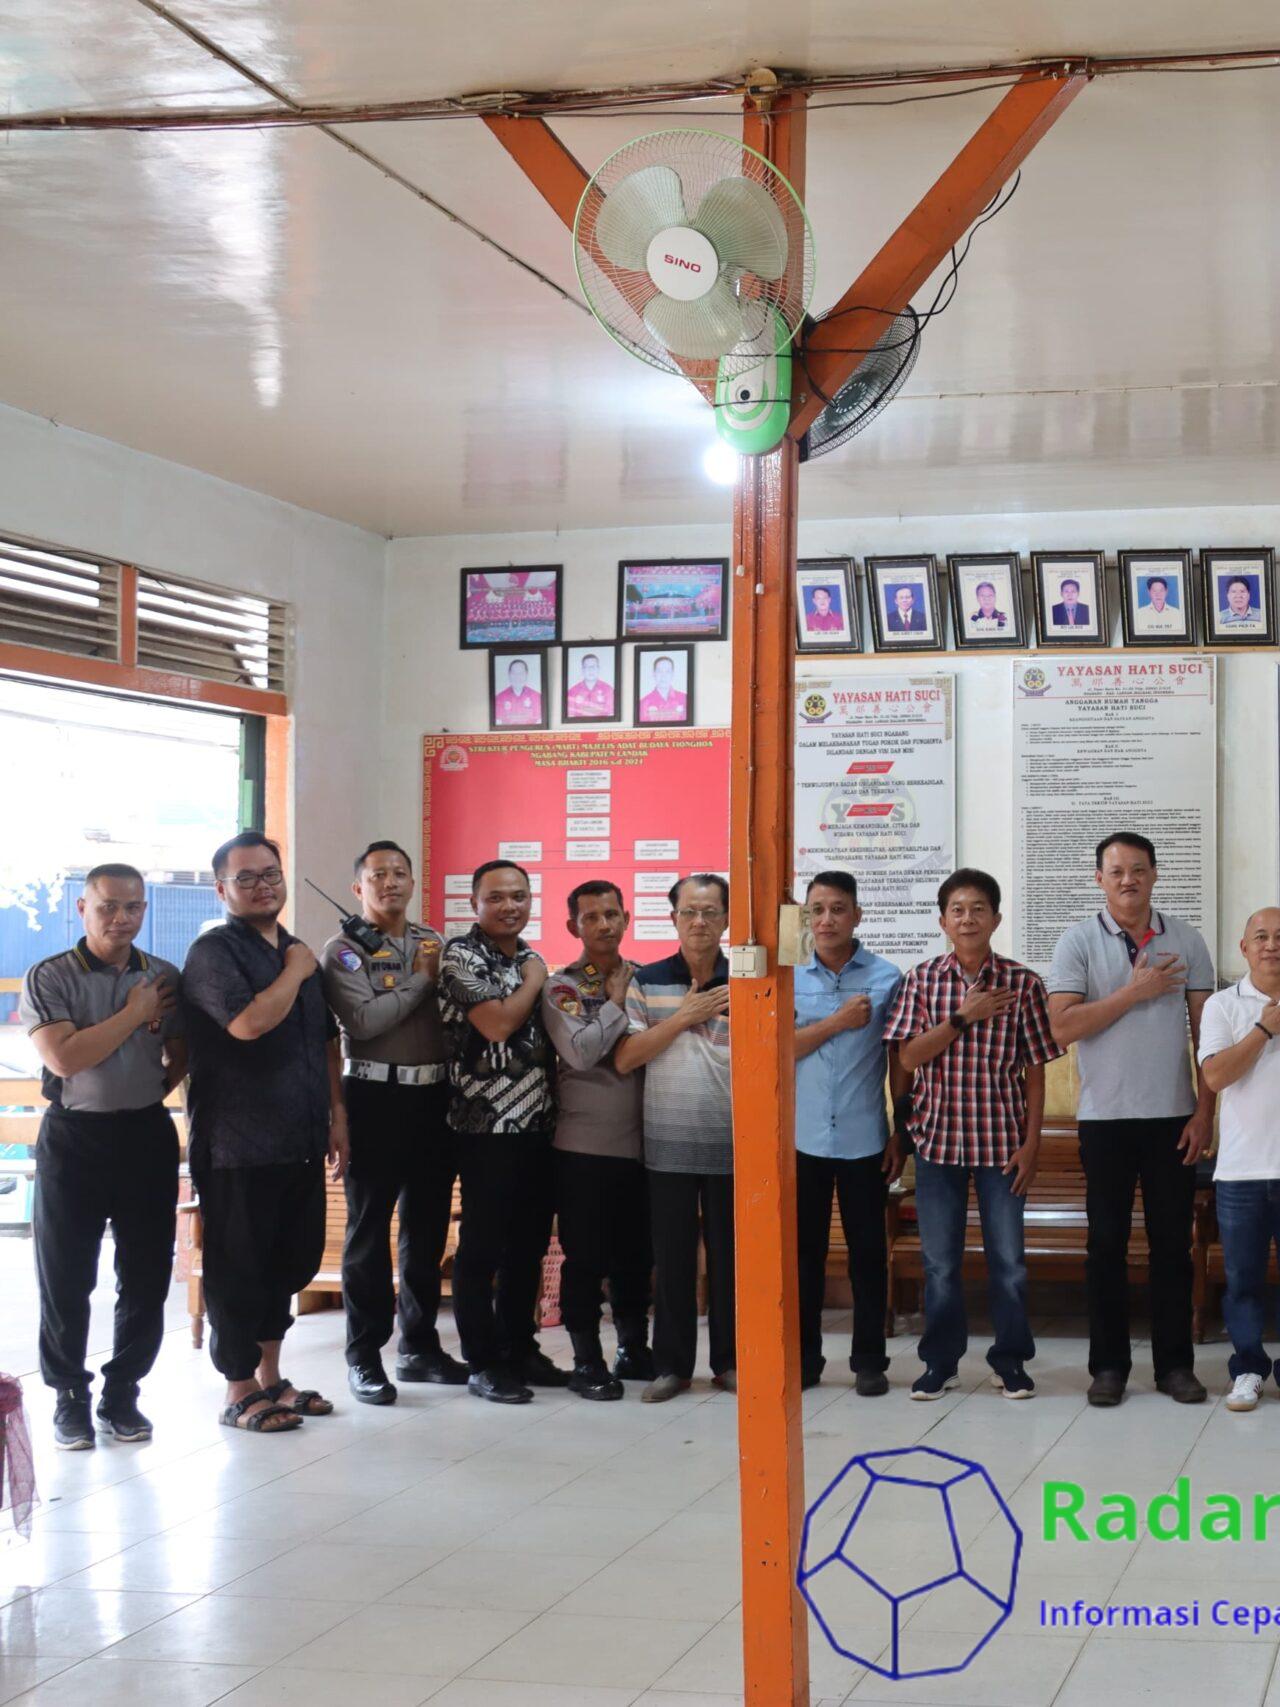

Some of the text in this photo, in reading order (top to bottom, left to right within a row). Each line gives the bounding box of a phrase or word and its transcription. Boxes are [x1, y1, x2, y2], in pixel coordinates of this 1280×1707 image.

[664, 254, 701, 274] SINO
[1057, 663, 1202, 677] YAYASAN HATI SUCI
[833, 689, 941, 703] YAYASAN HATI SUCI
